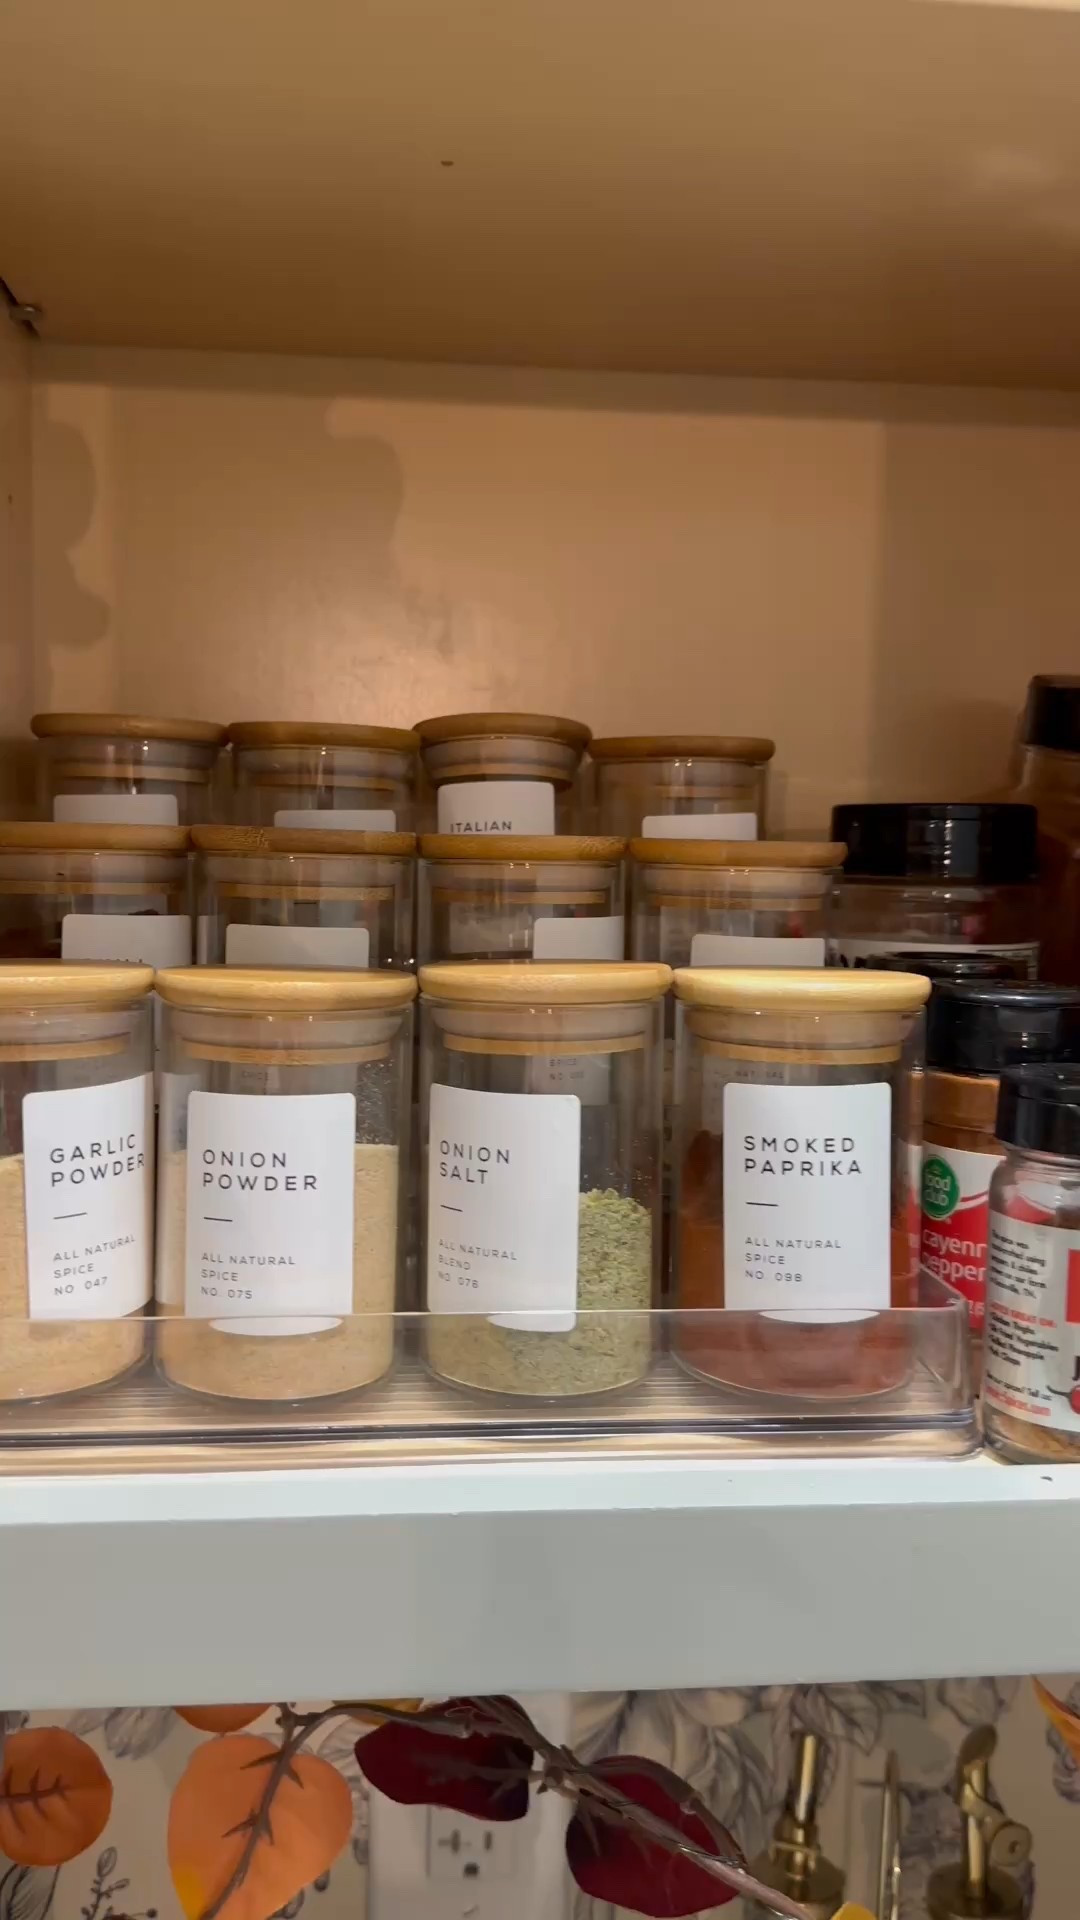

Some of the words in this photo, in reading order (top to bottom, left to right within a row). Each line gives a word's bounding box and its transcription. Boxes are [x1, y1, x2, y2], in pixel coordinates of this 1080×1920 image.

[449, 820, 512, 833] ITALIAN
[50, 1133, 136, 1164] GARLIC
[439, 1140, 510, 1165] ONION
[743, 1135, 856, 1153] SMOKED
[202, 1149, 287, 1168] ONION
[744, 1157, 862, 1177] PAPRIKA
[51, 1153, 145, 1187] POWDER
[439, 1161, 489, 1185] SALT
[202, 1172, 318, 1192] POWDER
[53, 1250, 79, 1262] ALL
[85, 1234, 136, 1256] NATURAL
[438, 1238, 455, 1251] ALL
[459, 1244, 517, 1261] NATURAL
[745, 1236, 770, 1248] ALL
[775, 1239, 841, 1249] NATURAL
[201, 1252, 224, 1263] ALL
[229, 1255, 296, 1266] NATURAL
[438, 1253, 471, 1271] BLEND
[745, 1252, 785, 1265] SPICE
[54, 1263, 95, 1279] SPICE
[201, 1269, 239, 1282] SPICE
[745, 1269, 764, 1280] NO
[54, 1284, 74, 1296] NO
[84, 1275, 108, 1290] 047
[201, 1286, 218, 1297] NO
